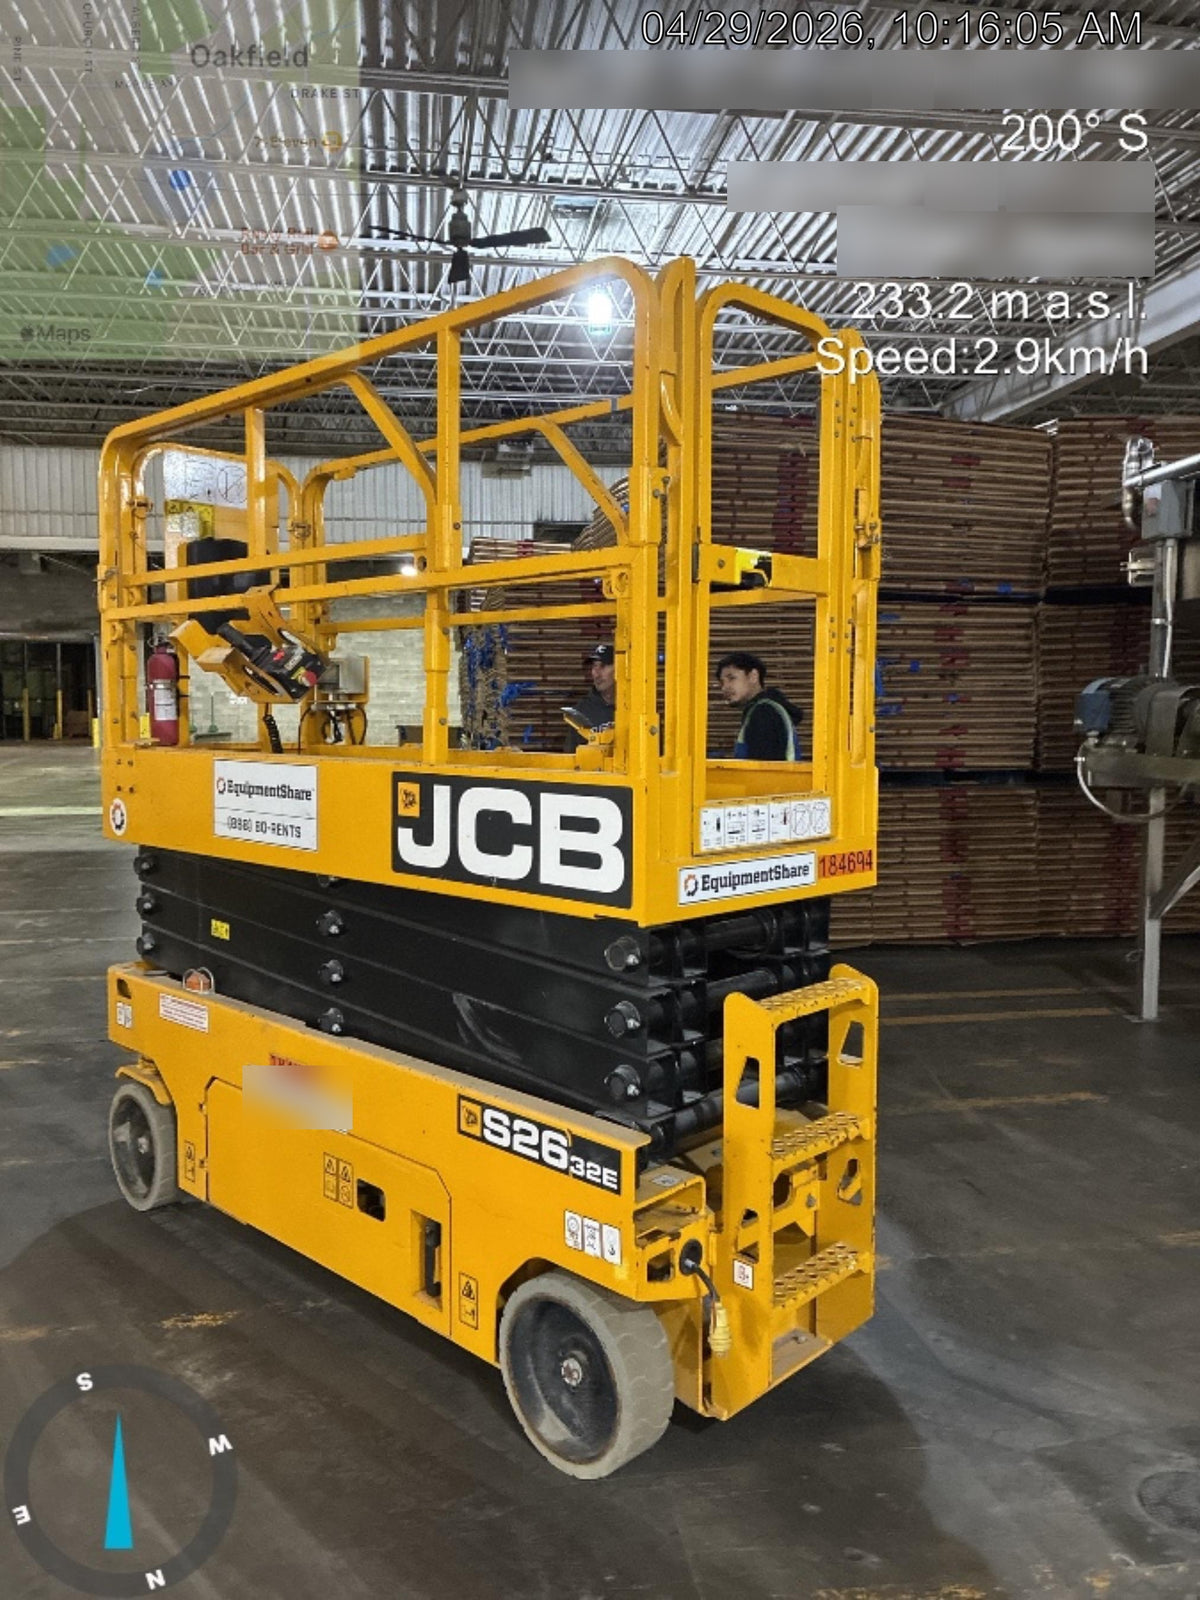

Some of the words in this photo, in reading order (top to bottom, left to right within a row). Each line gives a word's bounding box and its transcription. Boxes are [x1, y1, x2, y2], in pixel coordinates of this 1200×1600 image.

[227, 779, 312, 801] EquipmentShare
[398, 783, 625, 894] JCB
[701, 863, 810, 892] EquipmentShare
[818, 850, 874, 878] 184694
